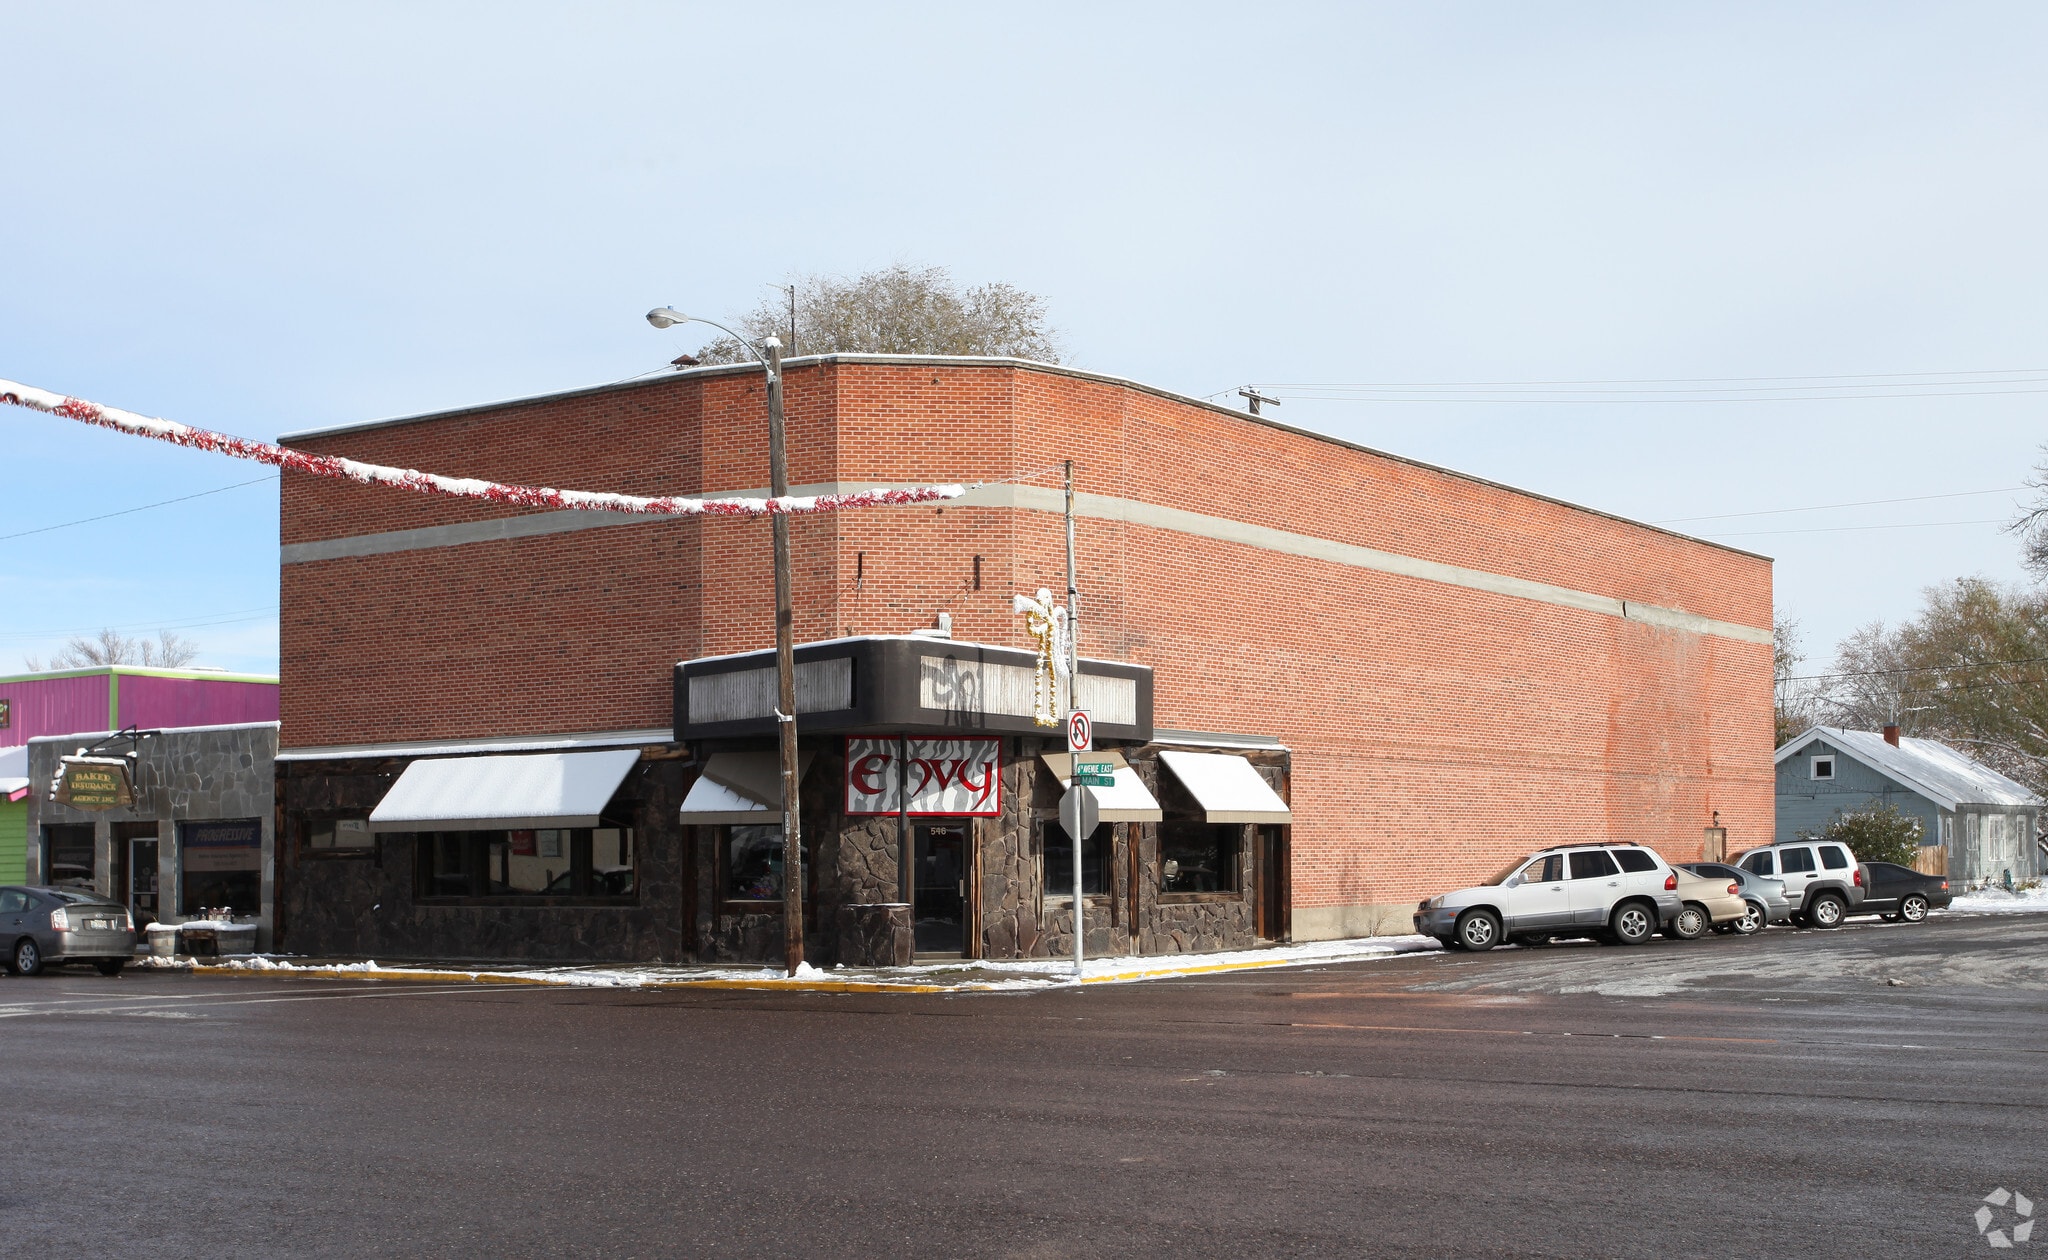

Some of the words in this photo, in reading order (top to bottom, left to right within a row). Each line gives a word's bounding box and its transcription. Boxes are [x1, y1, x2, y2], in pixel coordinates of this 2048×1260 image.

[1083, 764, 1100, 773] AVENUE
[1101, 764, 1113, 773] EAST
[75, 773, 111, 782] BAKER
[1082, 776, 1100, 785] MAIN
[71, 782, 117, 790] INSURANCE
[195, 827, 256, 842] PROGRESSIVE
[930, 827, 947, 835] 546
